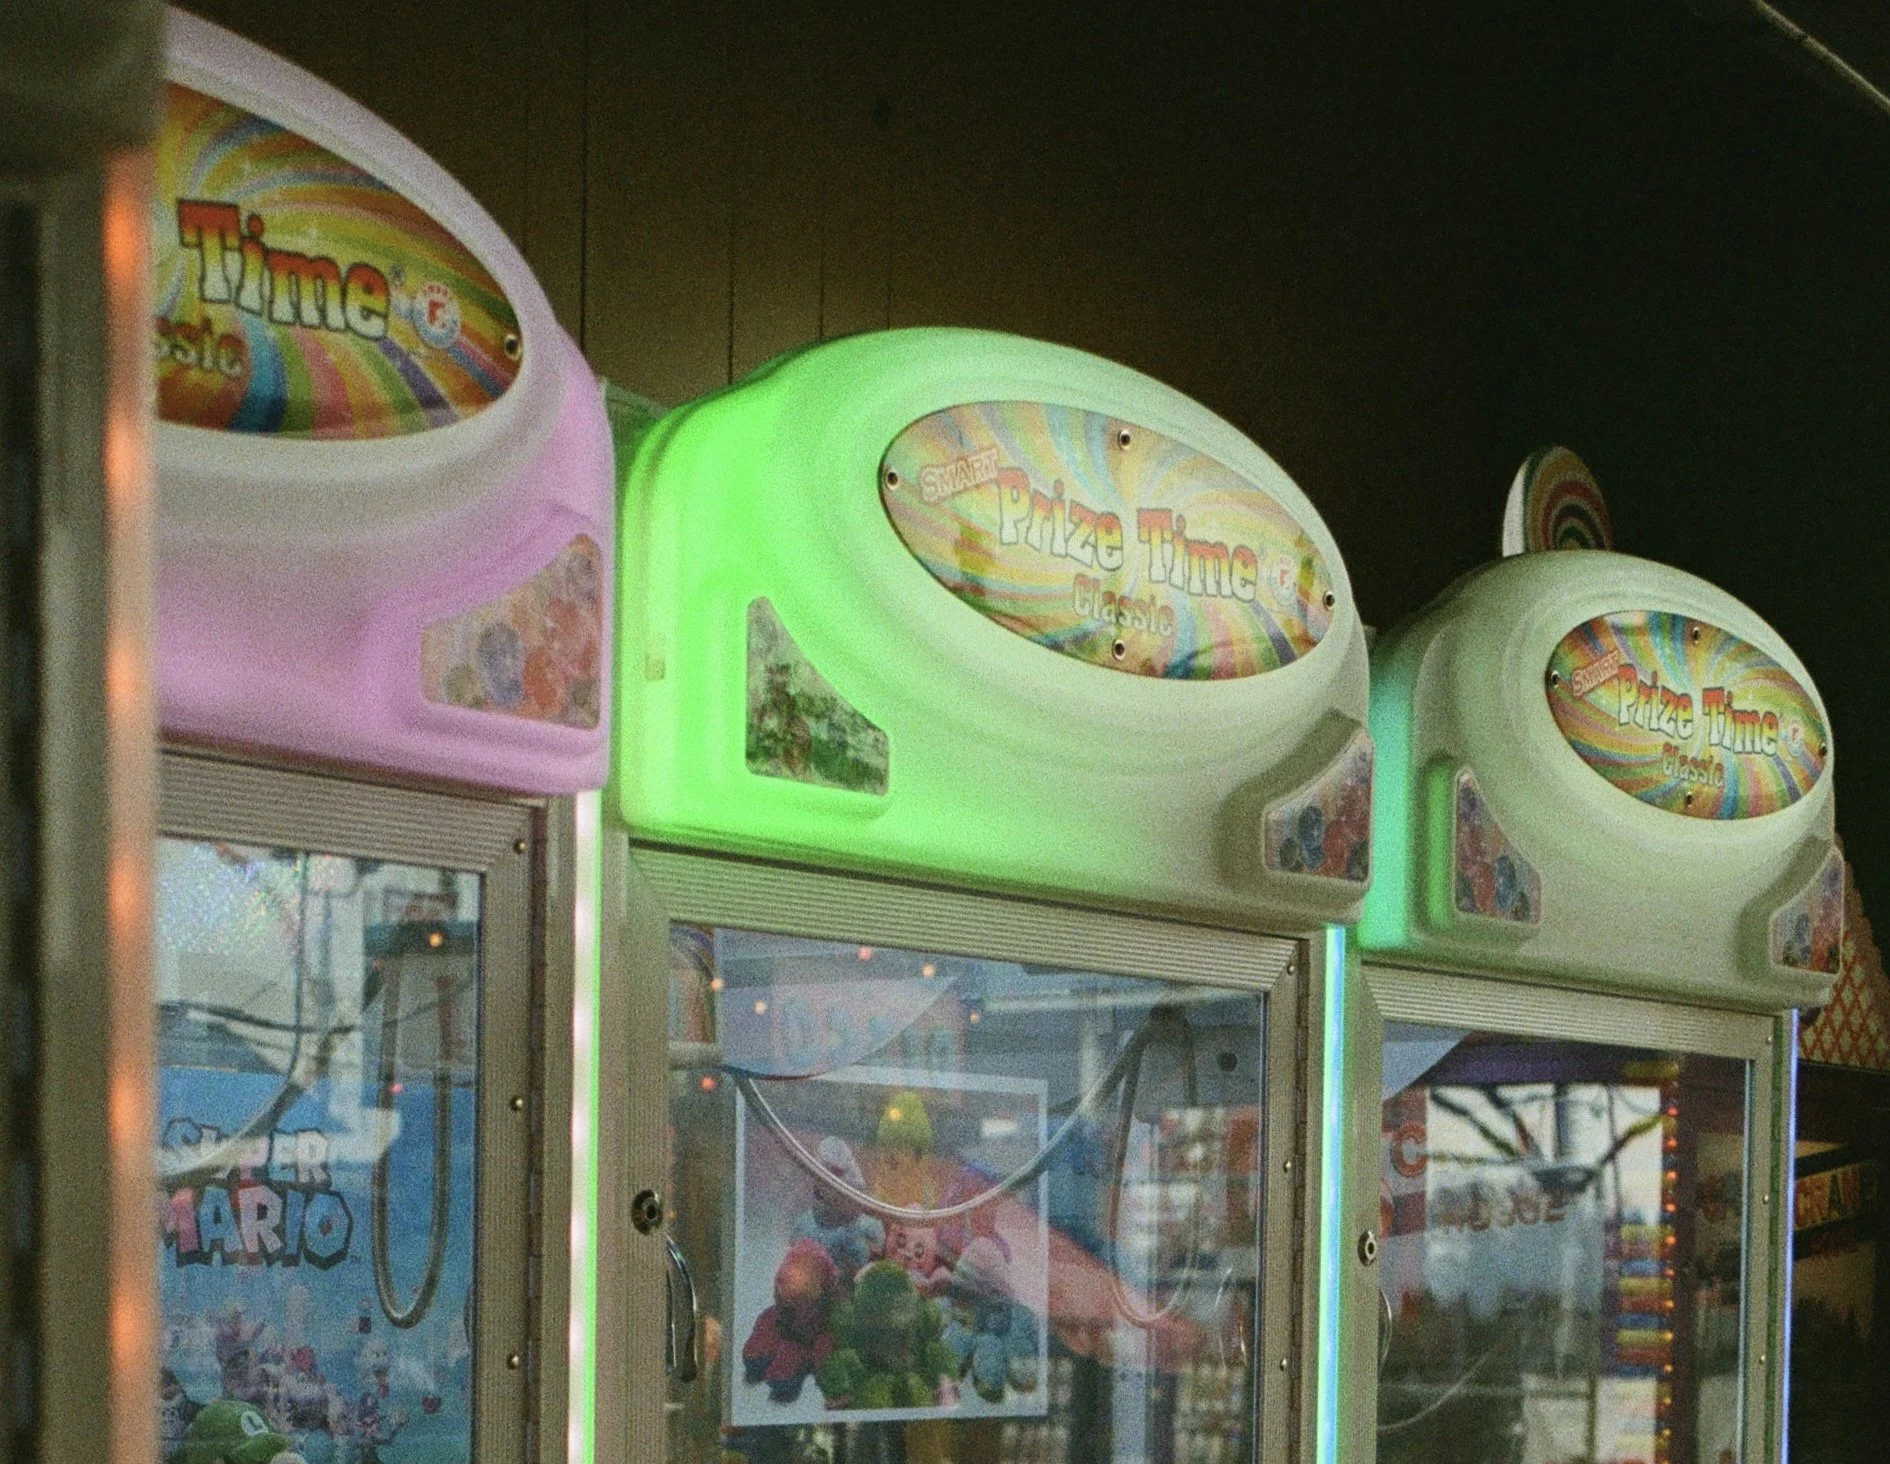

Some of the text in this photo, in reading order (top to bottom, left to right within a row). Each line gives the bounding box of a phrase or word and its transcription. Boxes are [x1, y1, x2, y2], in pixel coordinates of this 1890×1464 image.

[177, 198, 389, 342] Time
[997, 466, 1258, 603] Prize Time
[1072, 574, 1174, 637] Classic
[1617, 664, 1778, 756] Prize Time
[1662, 742, 1724, 789] Classic
[160, 1182, 353, 1270] MARIO
